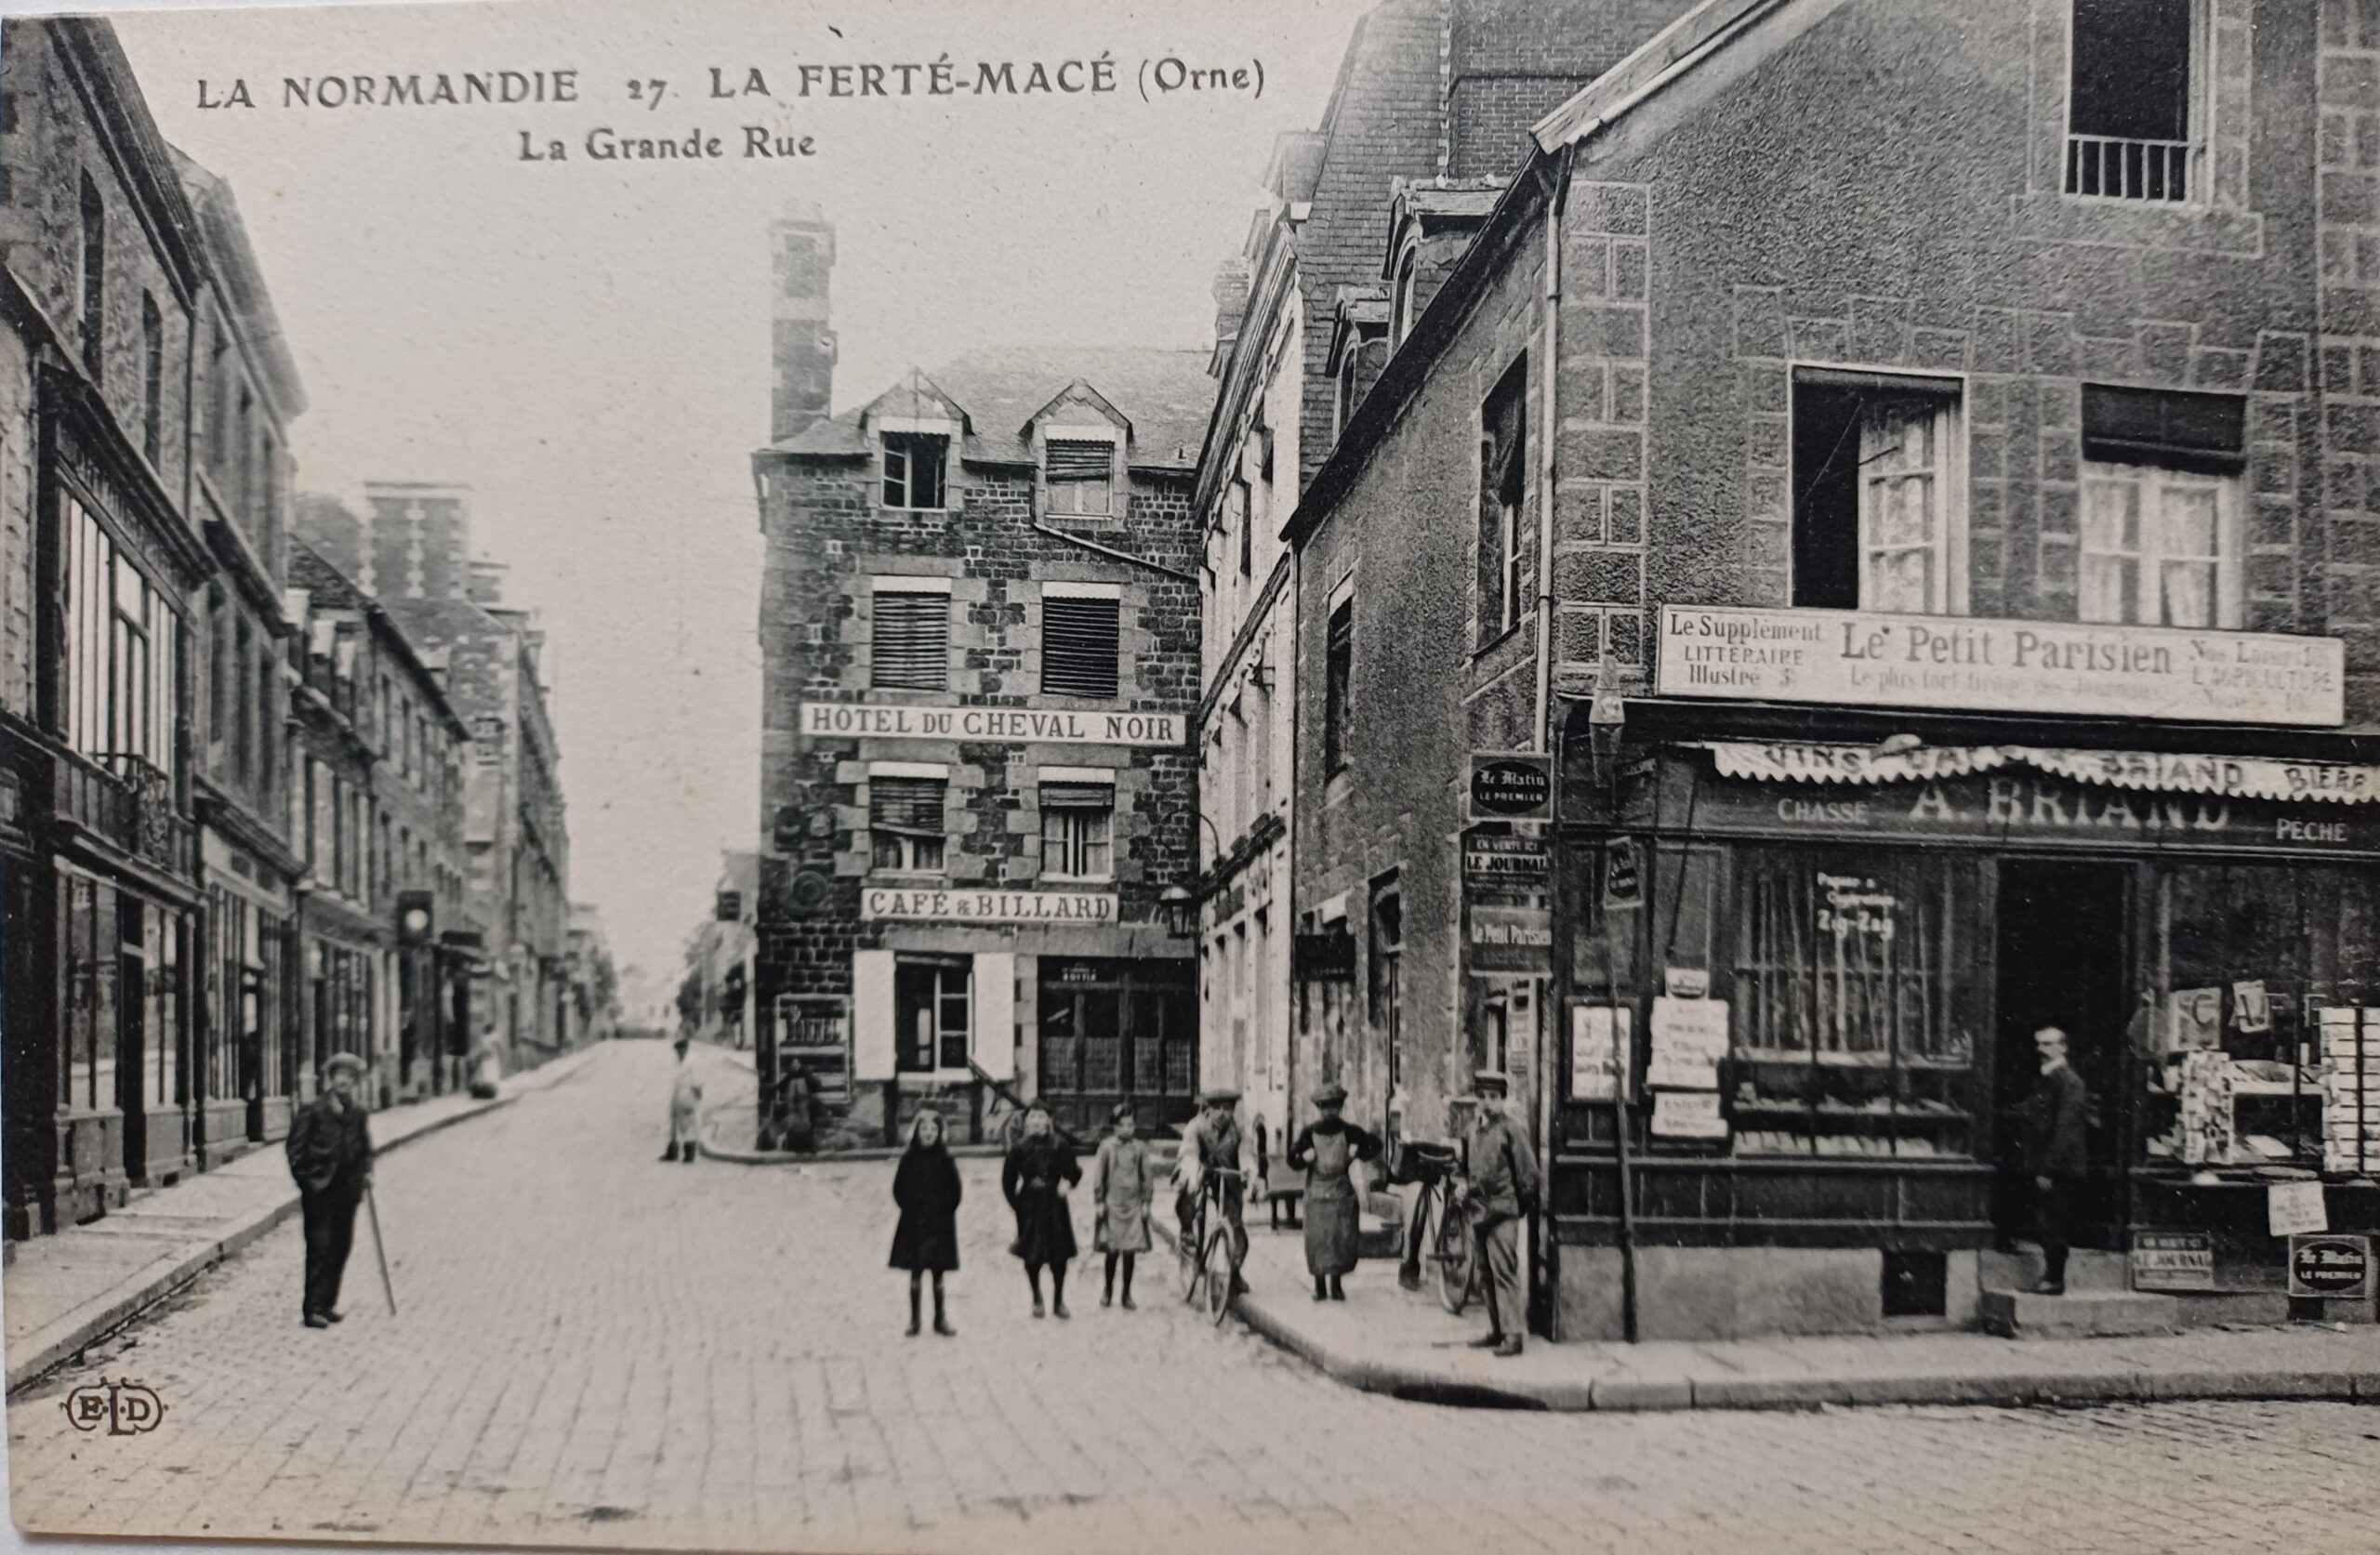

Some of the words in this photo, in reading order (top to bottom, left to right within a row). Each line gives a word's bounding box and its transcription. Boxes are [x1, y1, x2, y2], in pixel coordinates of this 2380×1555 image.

[1671, 613, 1694, 636] Le
[1840, 622, 1884, 659] Le
[1905, 625, 1993, 666] Petit
[2012, 630, 2174, 674] Parisien
[1689, 664, 1761, 686] Illustré
[922, 712, 954, 734] DU
[964, 713, 1085, 739] CHEVAL
[1105, 716, 1173, 742] NOIR
[1479, 770, 1495, 784] Le
[1501, 770, 1544, 786] Matin
[1494, 792, 1543, 802] PREMIER
[1777, 797, 1870, 826] CHASSE
[1986, 777, 2230, 830] BRIAND
[1467, 855, 1483, 870] LE
[1486, 856, 1546, 872] JOURNAL
[869, 891, 948, 916] CAFÉ
[957, 898, 971, 916] &
[976, 894, 1111, 920] BILLARD
